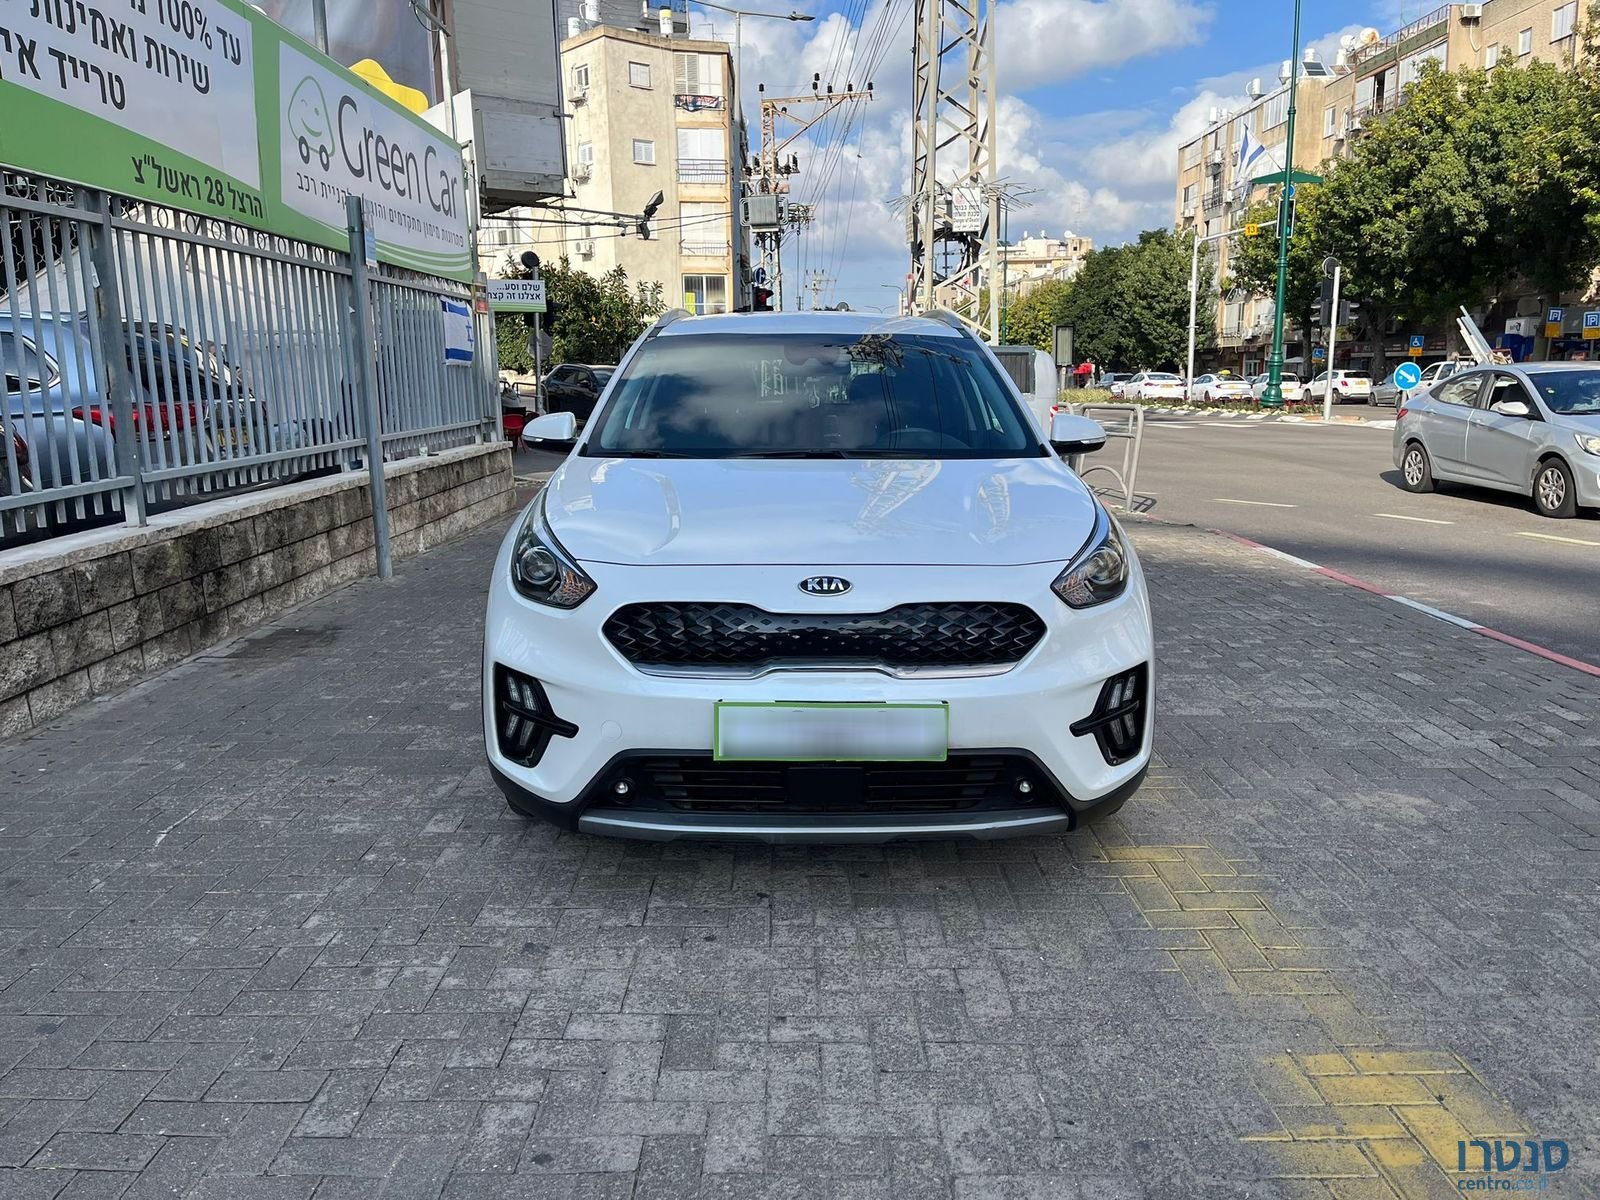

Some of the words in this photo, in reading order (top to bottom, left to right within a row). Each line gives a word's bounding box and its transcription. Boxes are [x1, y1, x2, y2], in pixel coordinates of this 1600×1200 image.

[216, 25, 241, 66] עד
[47, 46, 126, 110] טרייד
[143, 35, 210, 94] שירות
[338, 95, 422, 205] Green
[424, 145, 458, 219] Car
[130, 153, 202, 201] ראשל"צ
[205, 176, 226, 207] 28
[296, 172, 317, 196] רכב
[227, 182, 264, 219] הרצל
[1247, 225, 1256, 233] 13
[506, 292, 516, 300] זה
[517, 290, 541, 300] אצלנו
[521, 282, 541, 291] שלם
[806, 577, 845, 591] KIA
